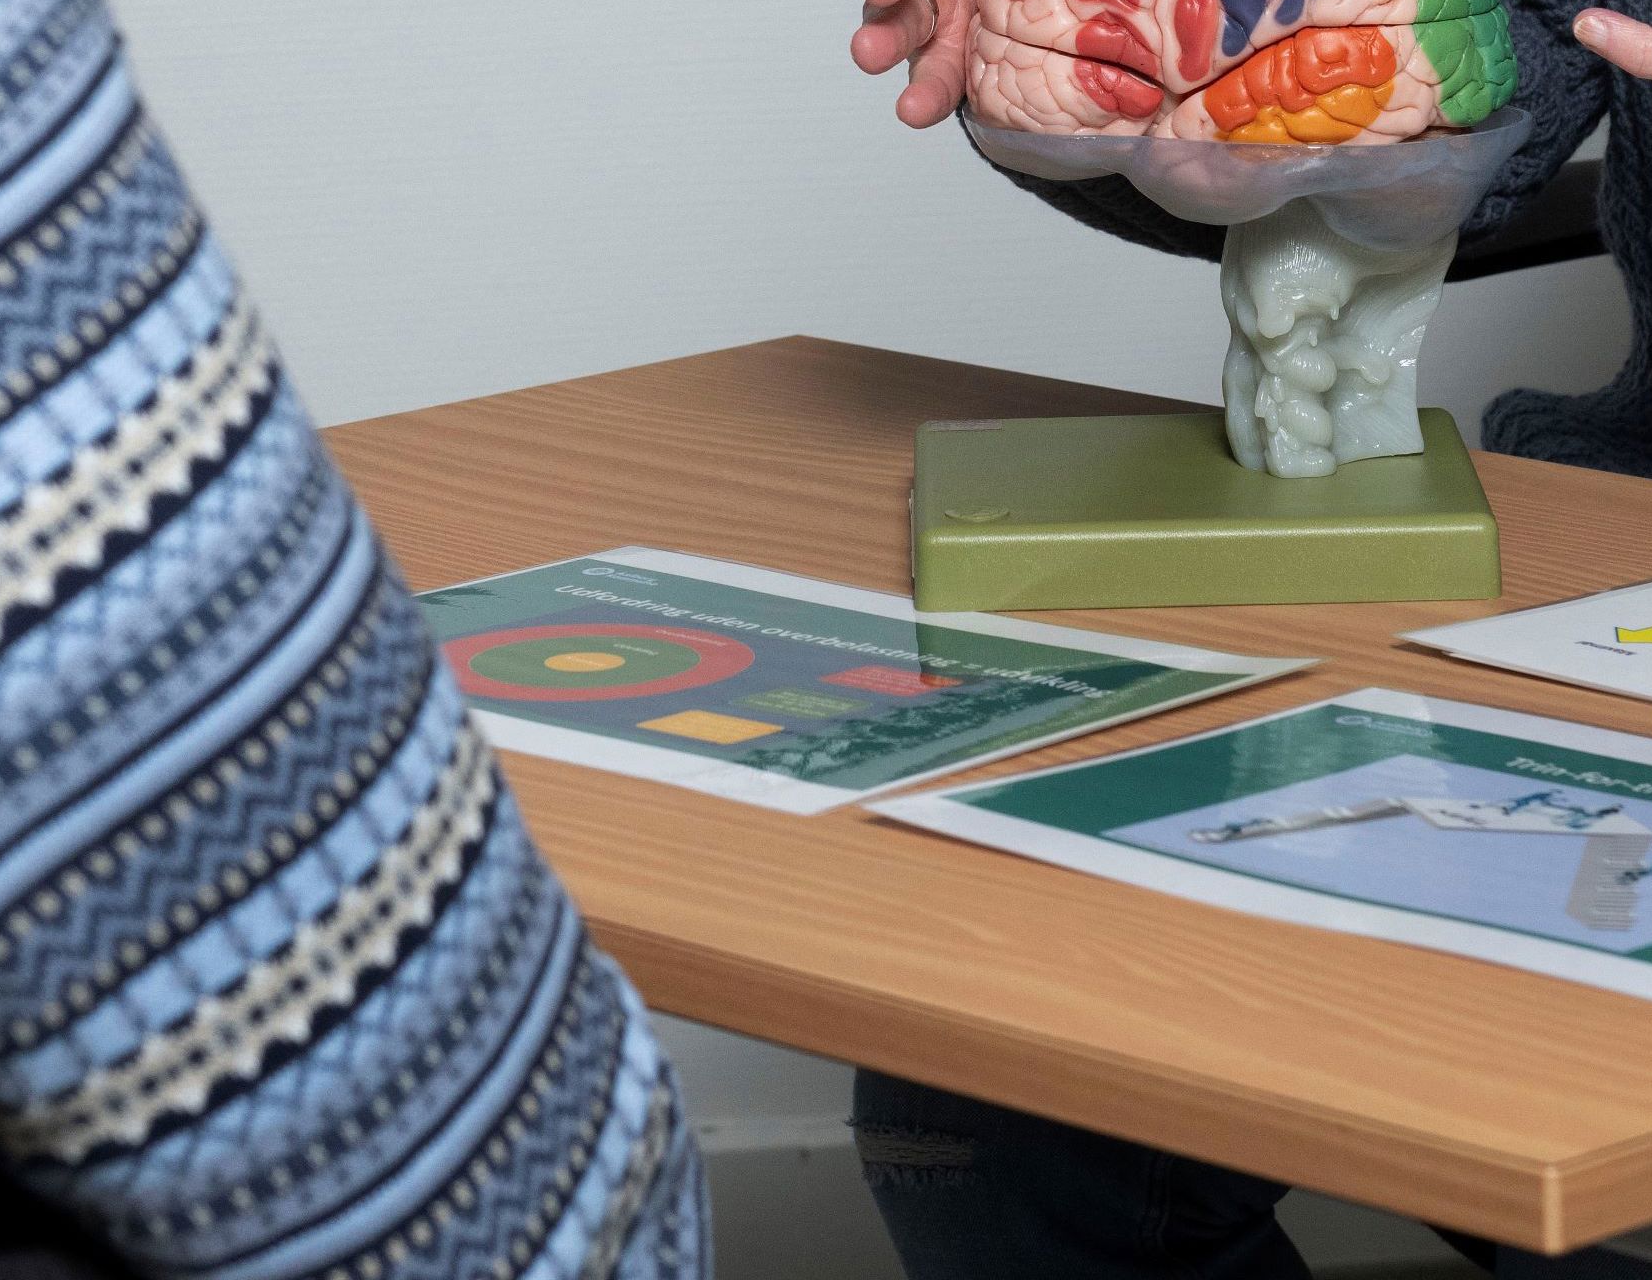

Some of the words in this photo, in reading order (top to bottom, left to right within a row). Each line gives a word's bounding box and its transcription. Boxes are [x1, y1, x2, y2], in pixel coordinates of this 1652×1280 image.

[555, 584, 693, 618] Udfordring
[691, 612, 760, 631] uden
[760, 626, 961, 668] overbelastning
[982, 666, 1114, 700] udvikling
